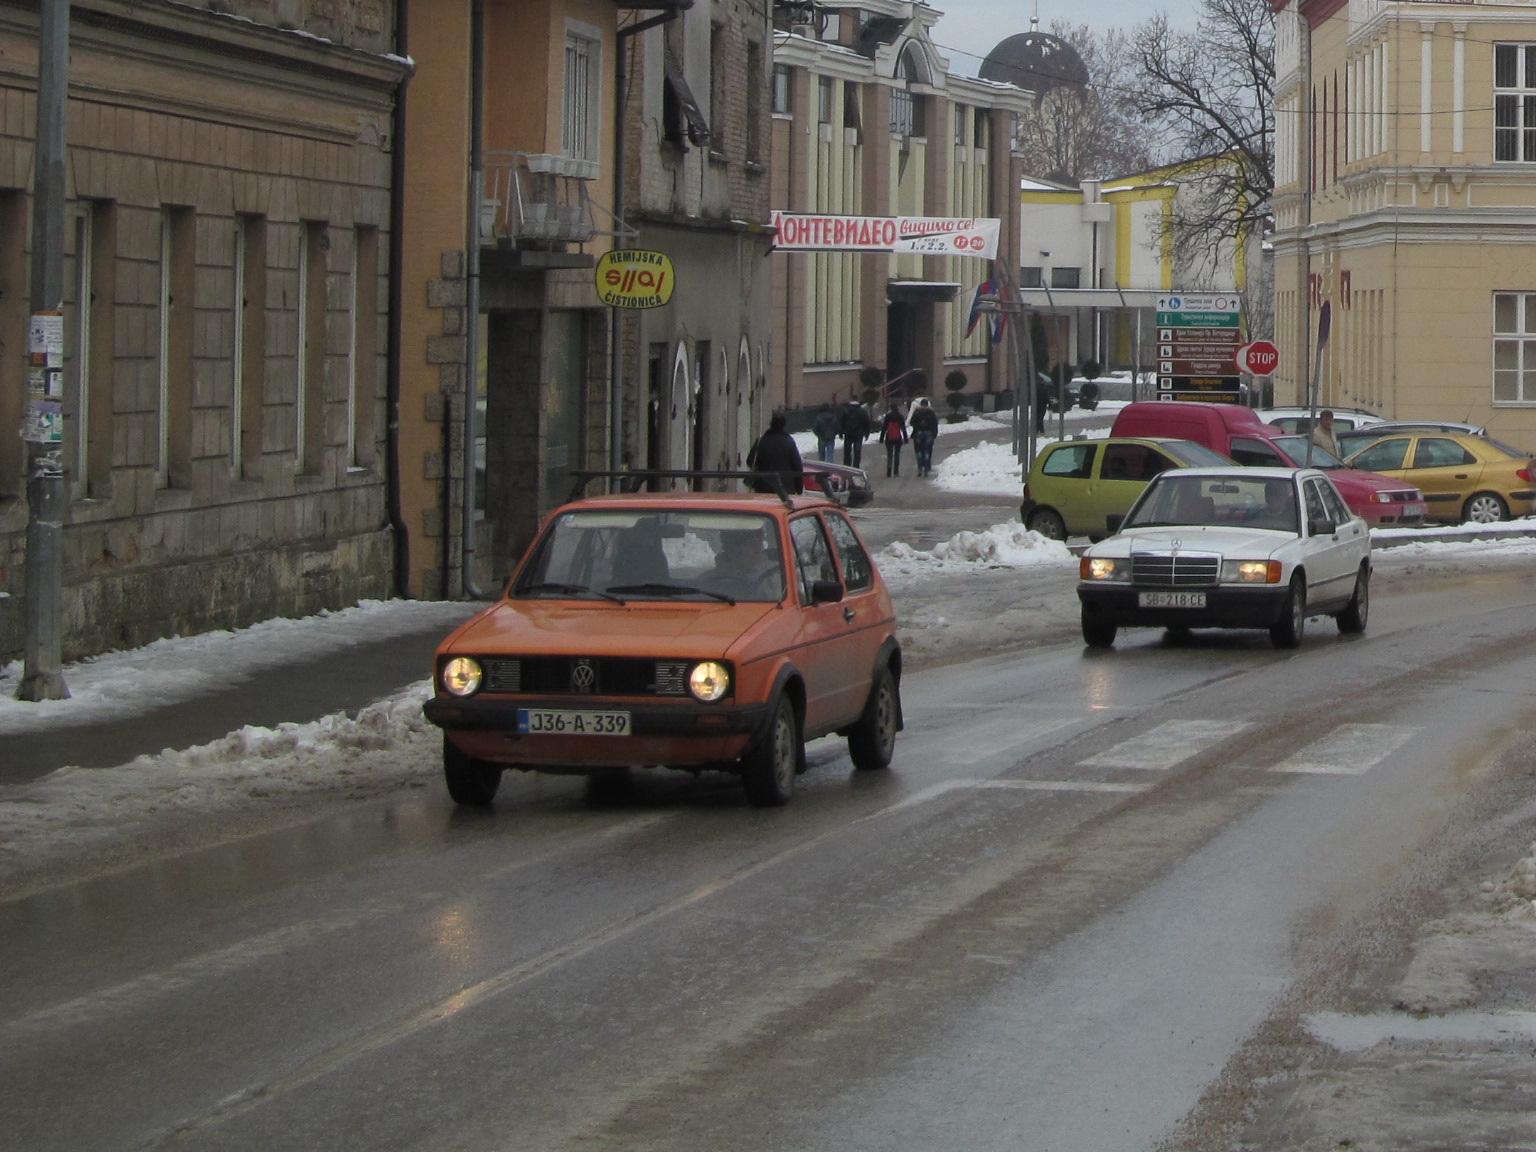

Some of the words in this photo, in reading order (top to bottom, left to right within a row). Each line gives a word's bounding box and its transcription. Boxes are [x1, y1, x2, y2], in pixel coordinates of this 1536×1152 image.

[972, 239, 984, 248] 20
[609, 251, 663, 266] HEMIJSKA
[604, 290, 662, 307] ČISTIONICA
[1248, 352, 1276, 365] STOP
[531, 712, 627, 733] J36-A-339
